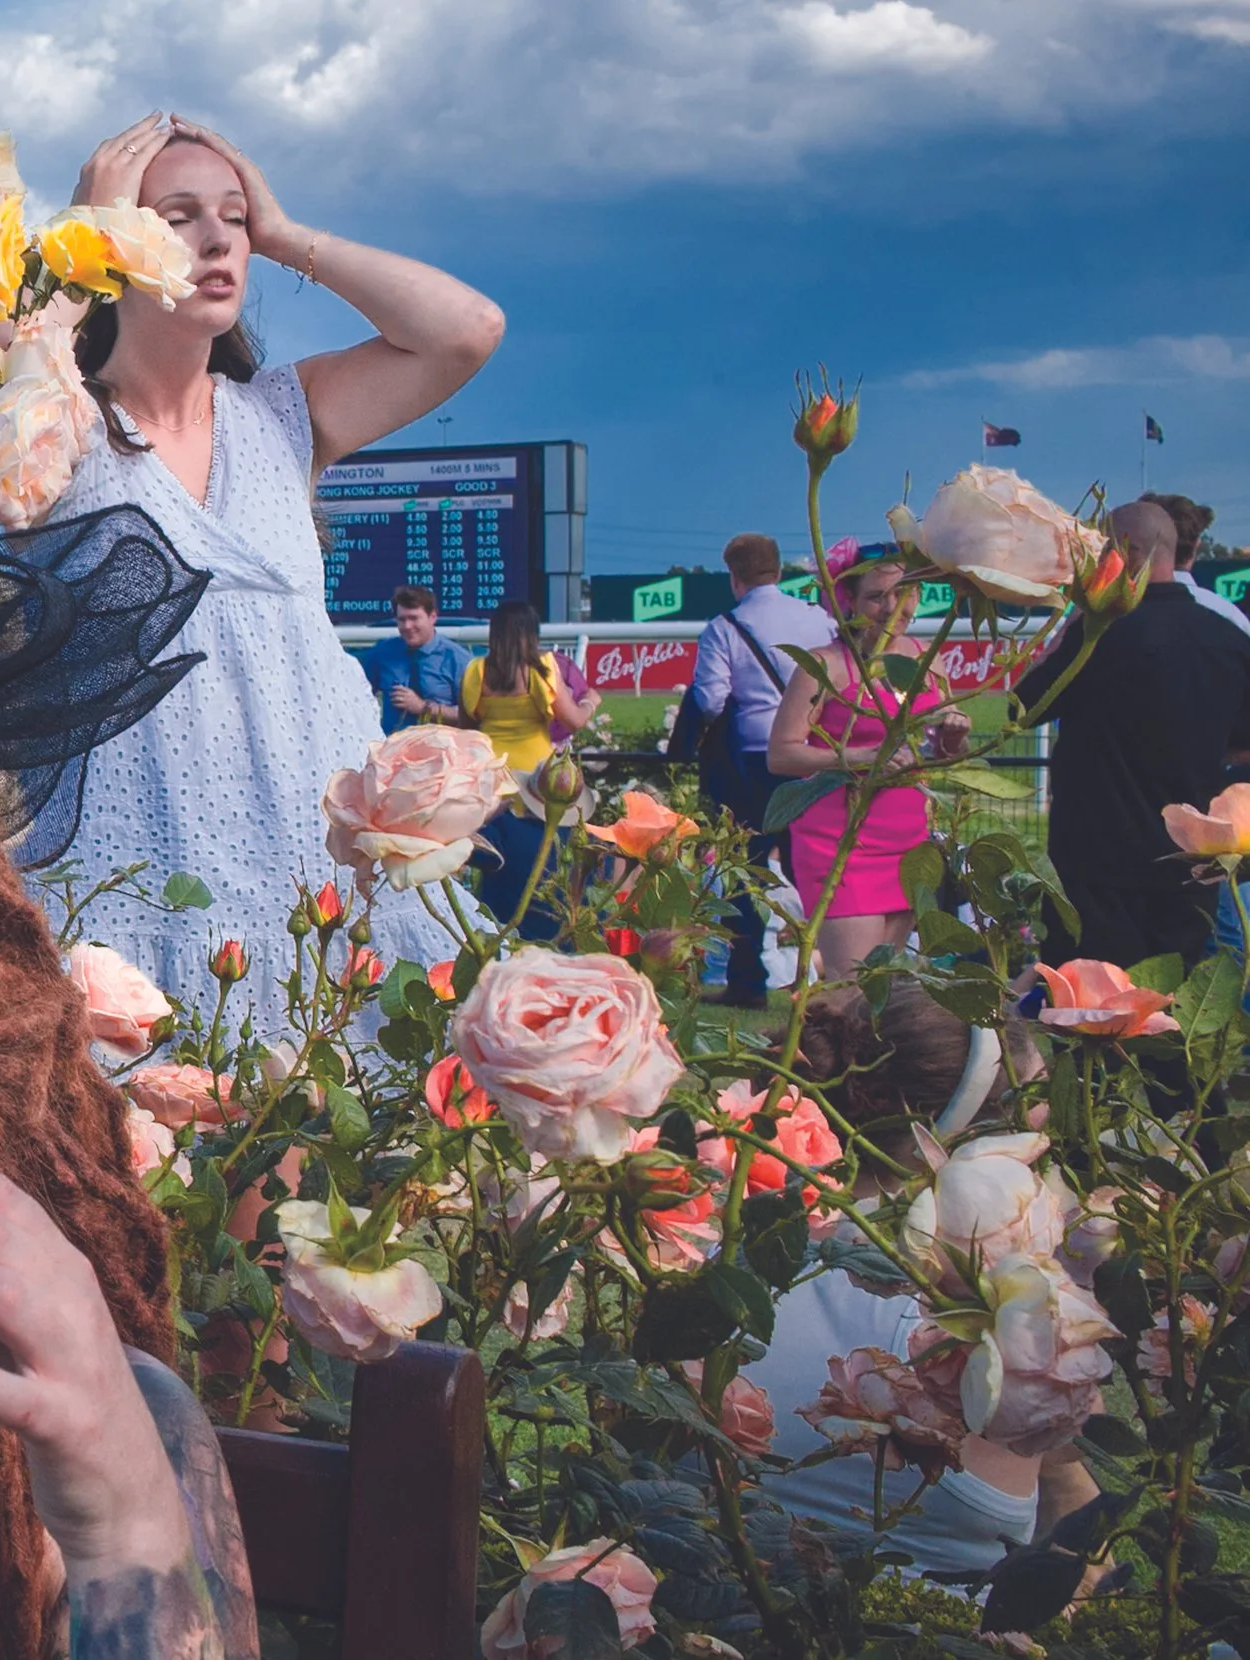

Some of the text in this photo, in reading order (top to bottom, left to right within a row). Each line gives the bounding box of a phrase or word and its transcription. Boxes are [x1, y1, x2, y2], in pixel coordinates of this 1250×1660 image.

[322, 467, 384, 480] MINGTON
[344, 486, 374, 497] KONG
[376, 484, 420, 496] JOCKEY
[454, 481, 488, 492] GOOD
[406, 550, 430, 559] SCR
[442, 548, 465, 559] SCR
[477, 548, 501, 558] SCR
[638, 592, 676, 607] TAB
[920, 586, 955, 602] AB
[343, 600, 380, 611] ROUGE
[596, 641, 685, 685] Penfolds
